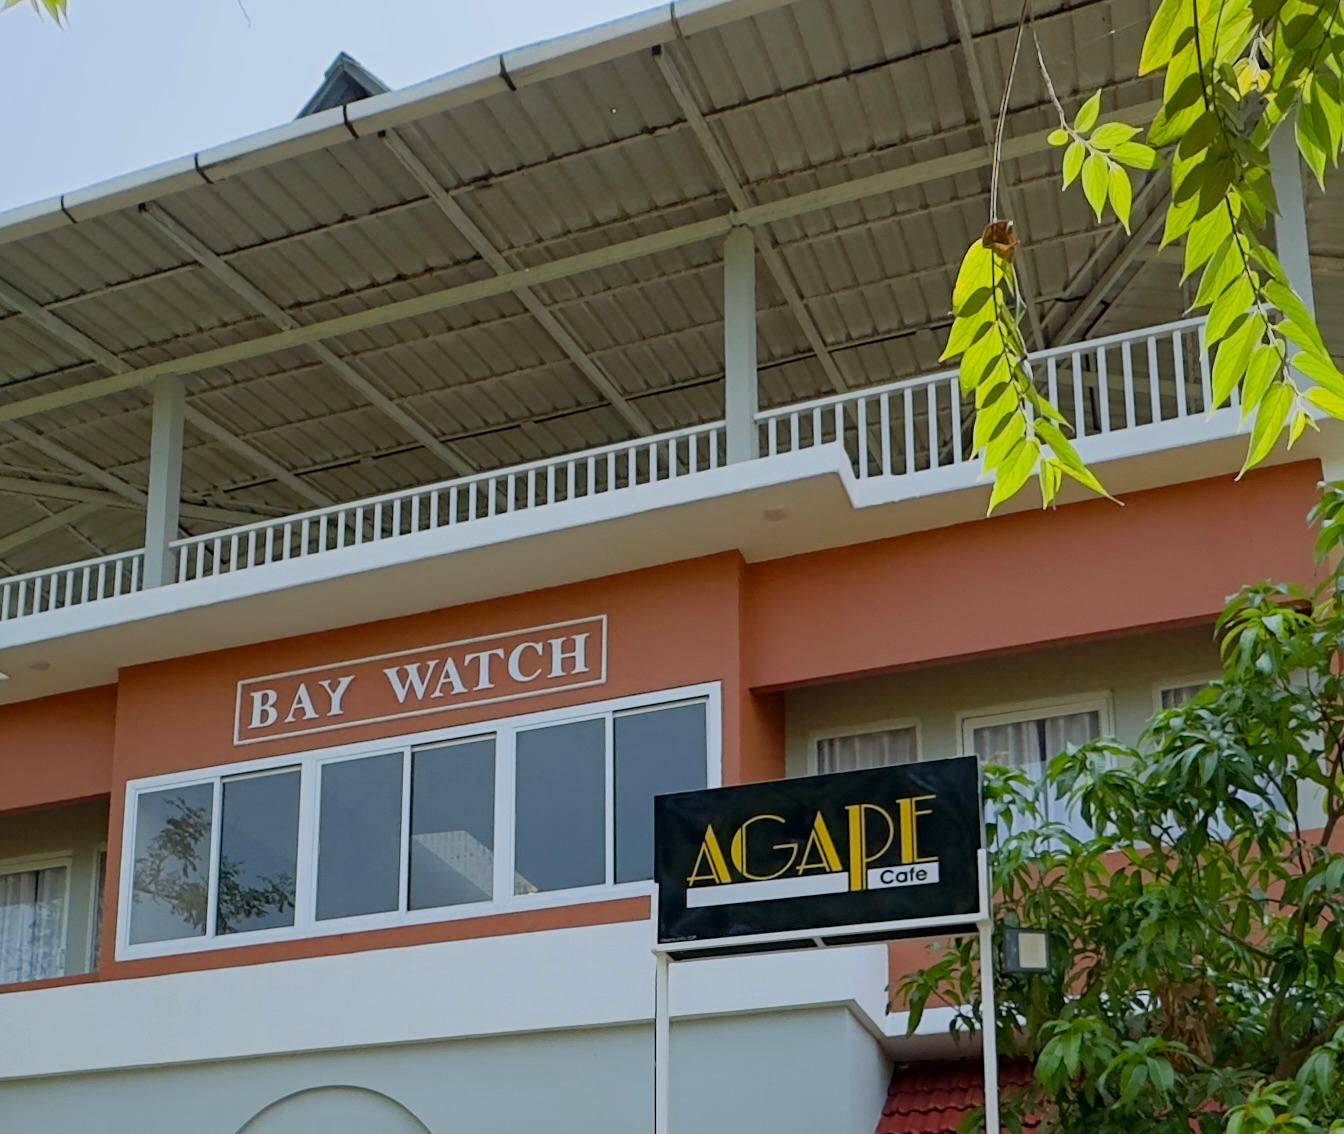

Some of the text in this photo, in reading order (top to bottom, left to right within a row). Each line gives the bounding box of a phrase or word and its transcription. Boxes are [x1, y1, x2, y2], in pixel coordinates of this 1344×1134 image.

[248, 633, 591, 729] BAY WATCH
[687, 795, 939, 892] AGAPE
[880, 866, 928, 885] Cafe
